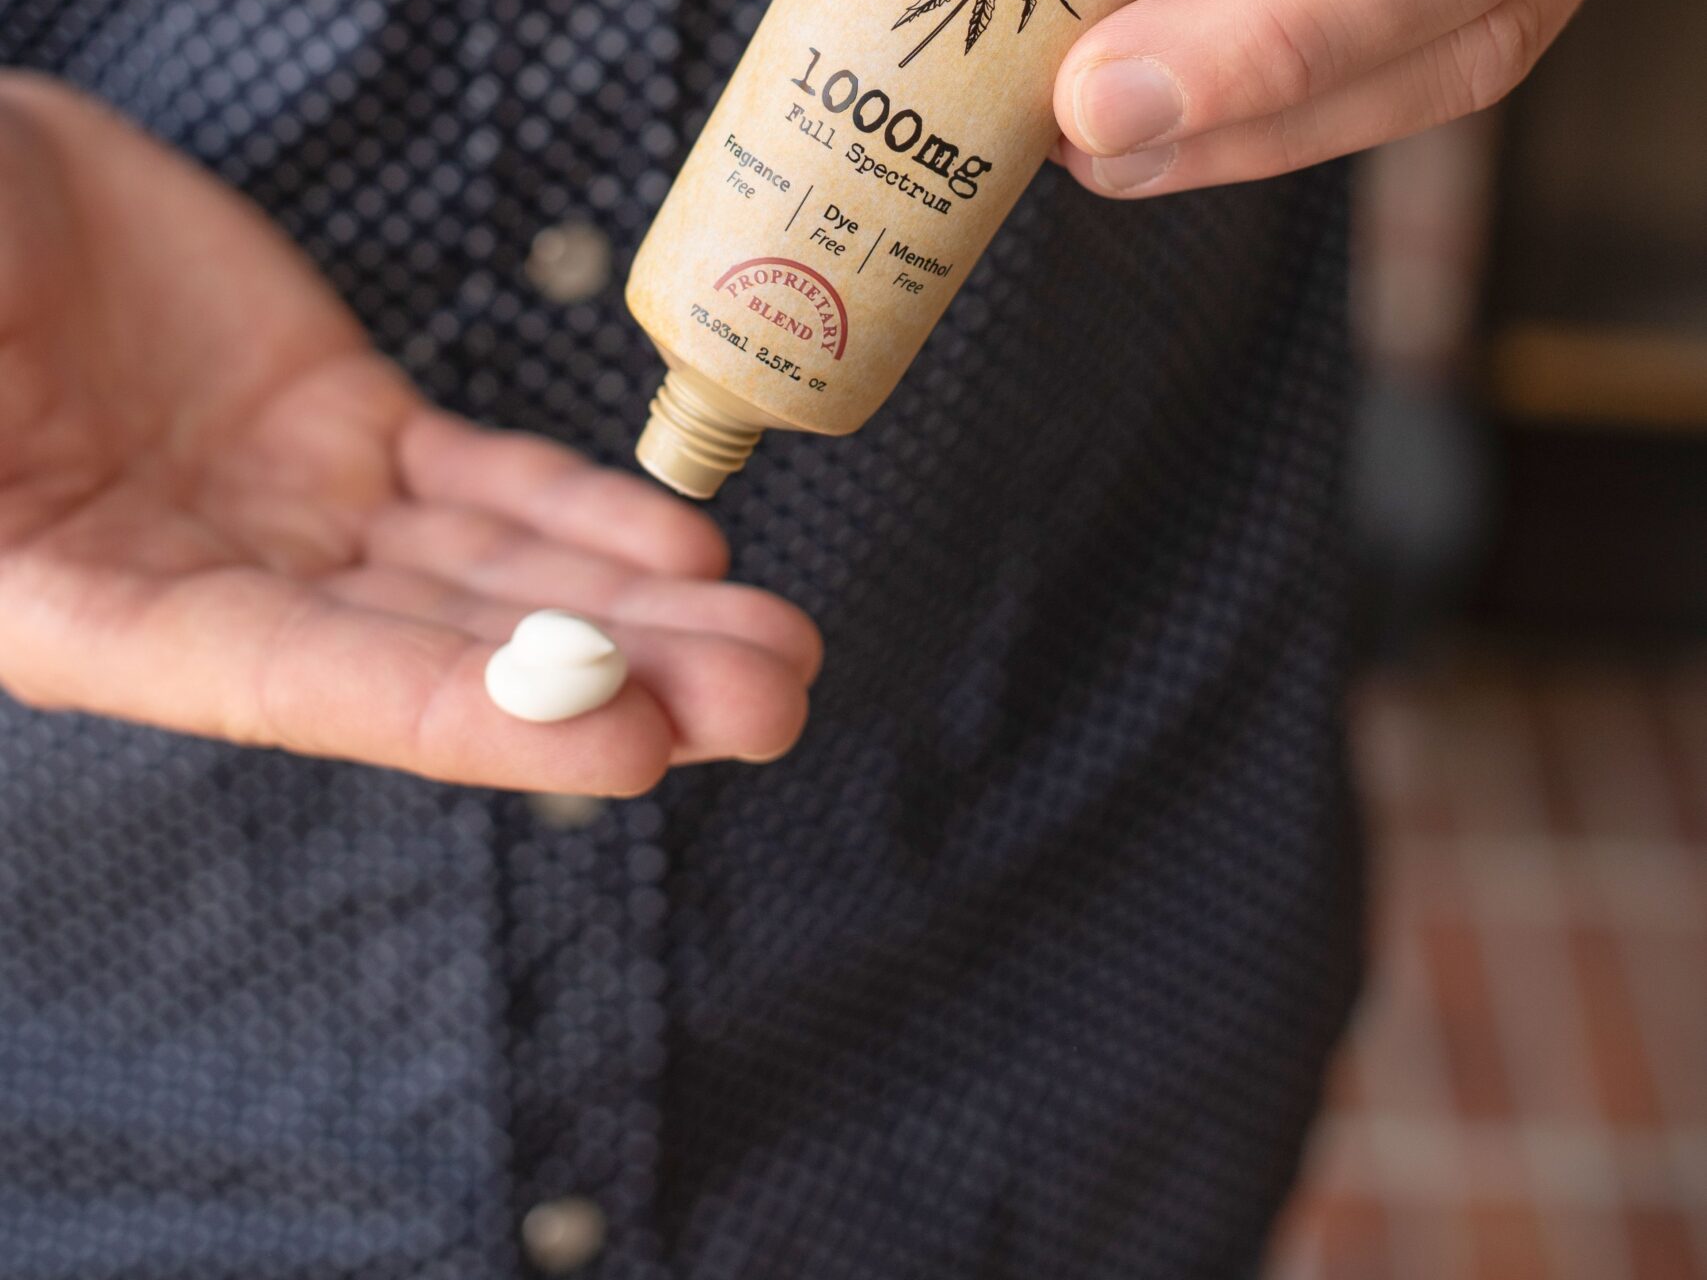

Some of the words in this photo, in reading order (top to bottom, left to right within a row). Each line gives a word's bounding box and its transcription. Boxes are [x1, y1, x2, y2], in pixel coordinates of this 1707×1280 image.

[790, 47, 992, 199] 1000mg
[724, 134, 791, 193] Fragrance
[785, 103, 834, 150] Full
[845, 142, 952, 214] Spectrum
[726, 170, 756, 200] Free
[809, 227, 846, 256] Free
[824, 204, 859, 234] Dye
[889, 241, 953, 278] Menthol
[893, 272, 924, 295] Free
[726, 269, 838, 354] PROPRIETARY
[747, 296, 813, 341] BLEND
[690, 304, 748, 352] 73.93ml
[755, 346, 802, 381] 2.5FL
[808, 377, 827, 391] oz
